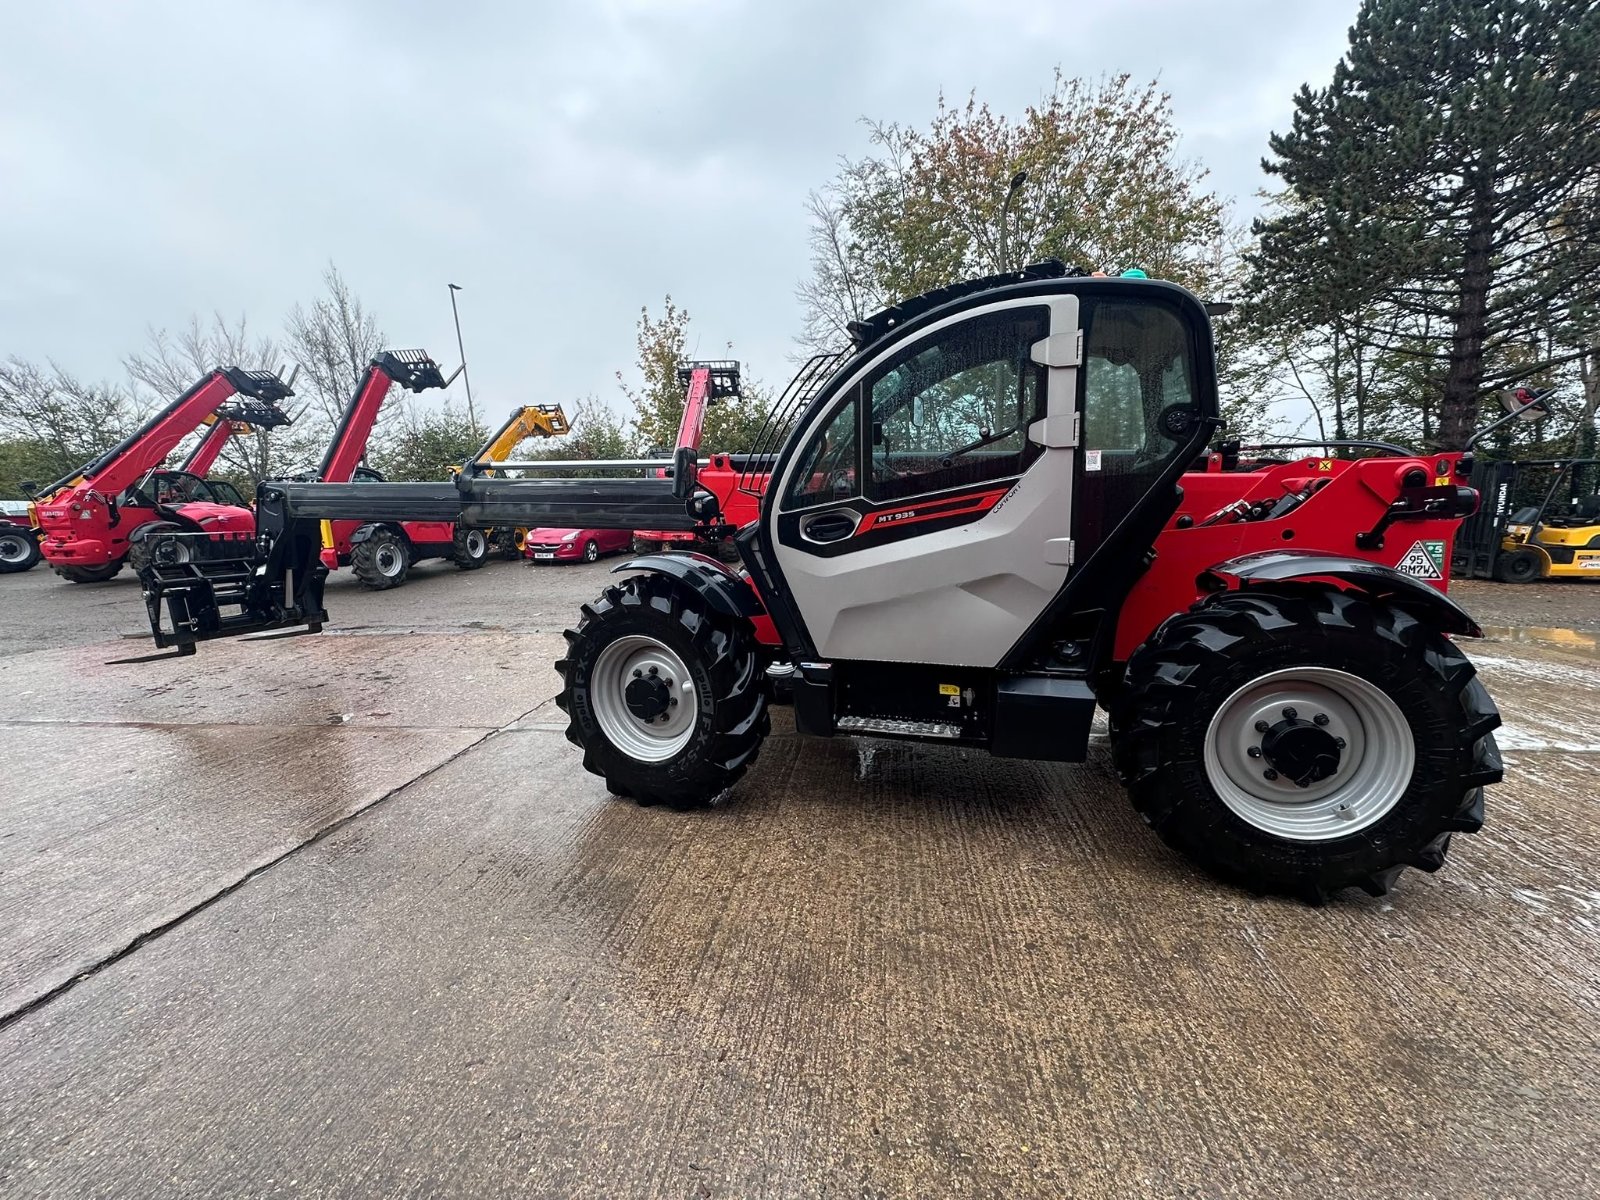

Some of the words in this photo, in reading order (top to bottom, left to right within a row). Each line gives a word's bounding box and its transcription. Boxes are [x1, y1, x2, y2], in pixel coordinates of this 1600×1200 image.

[992, 484, 1021, 514] COMFORT
[878, 514, 894, 523] MT
[895, 510, 915, 520] 935
[1409, 555, 1424, 565] 95
[694, 667, 712, 707] apollo
[575, 694, 592, 730] apollo
